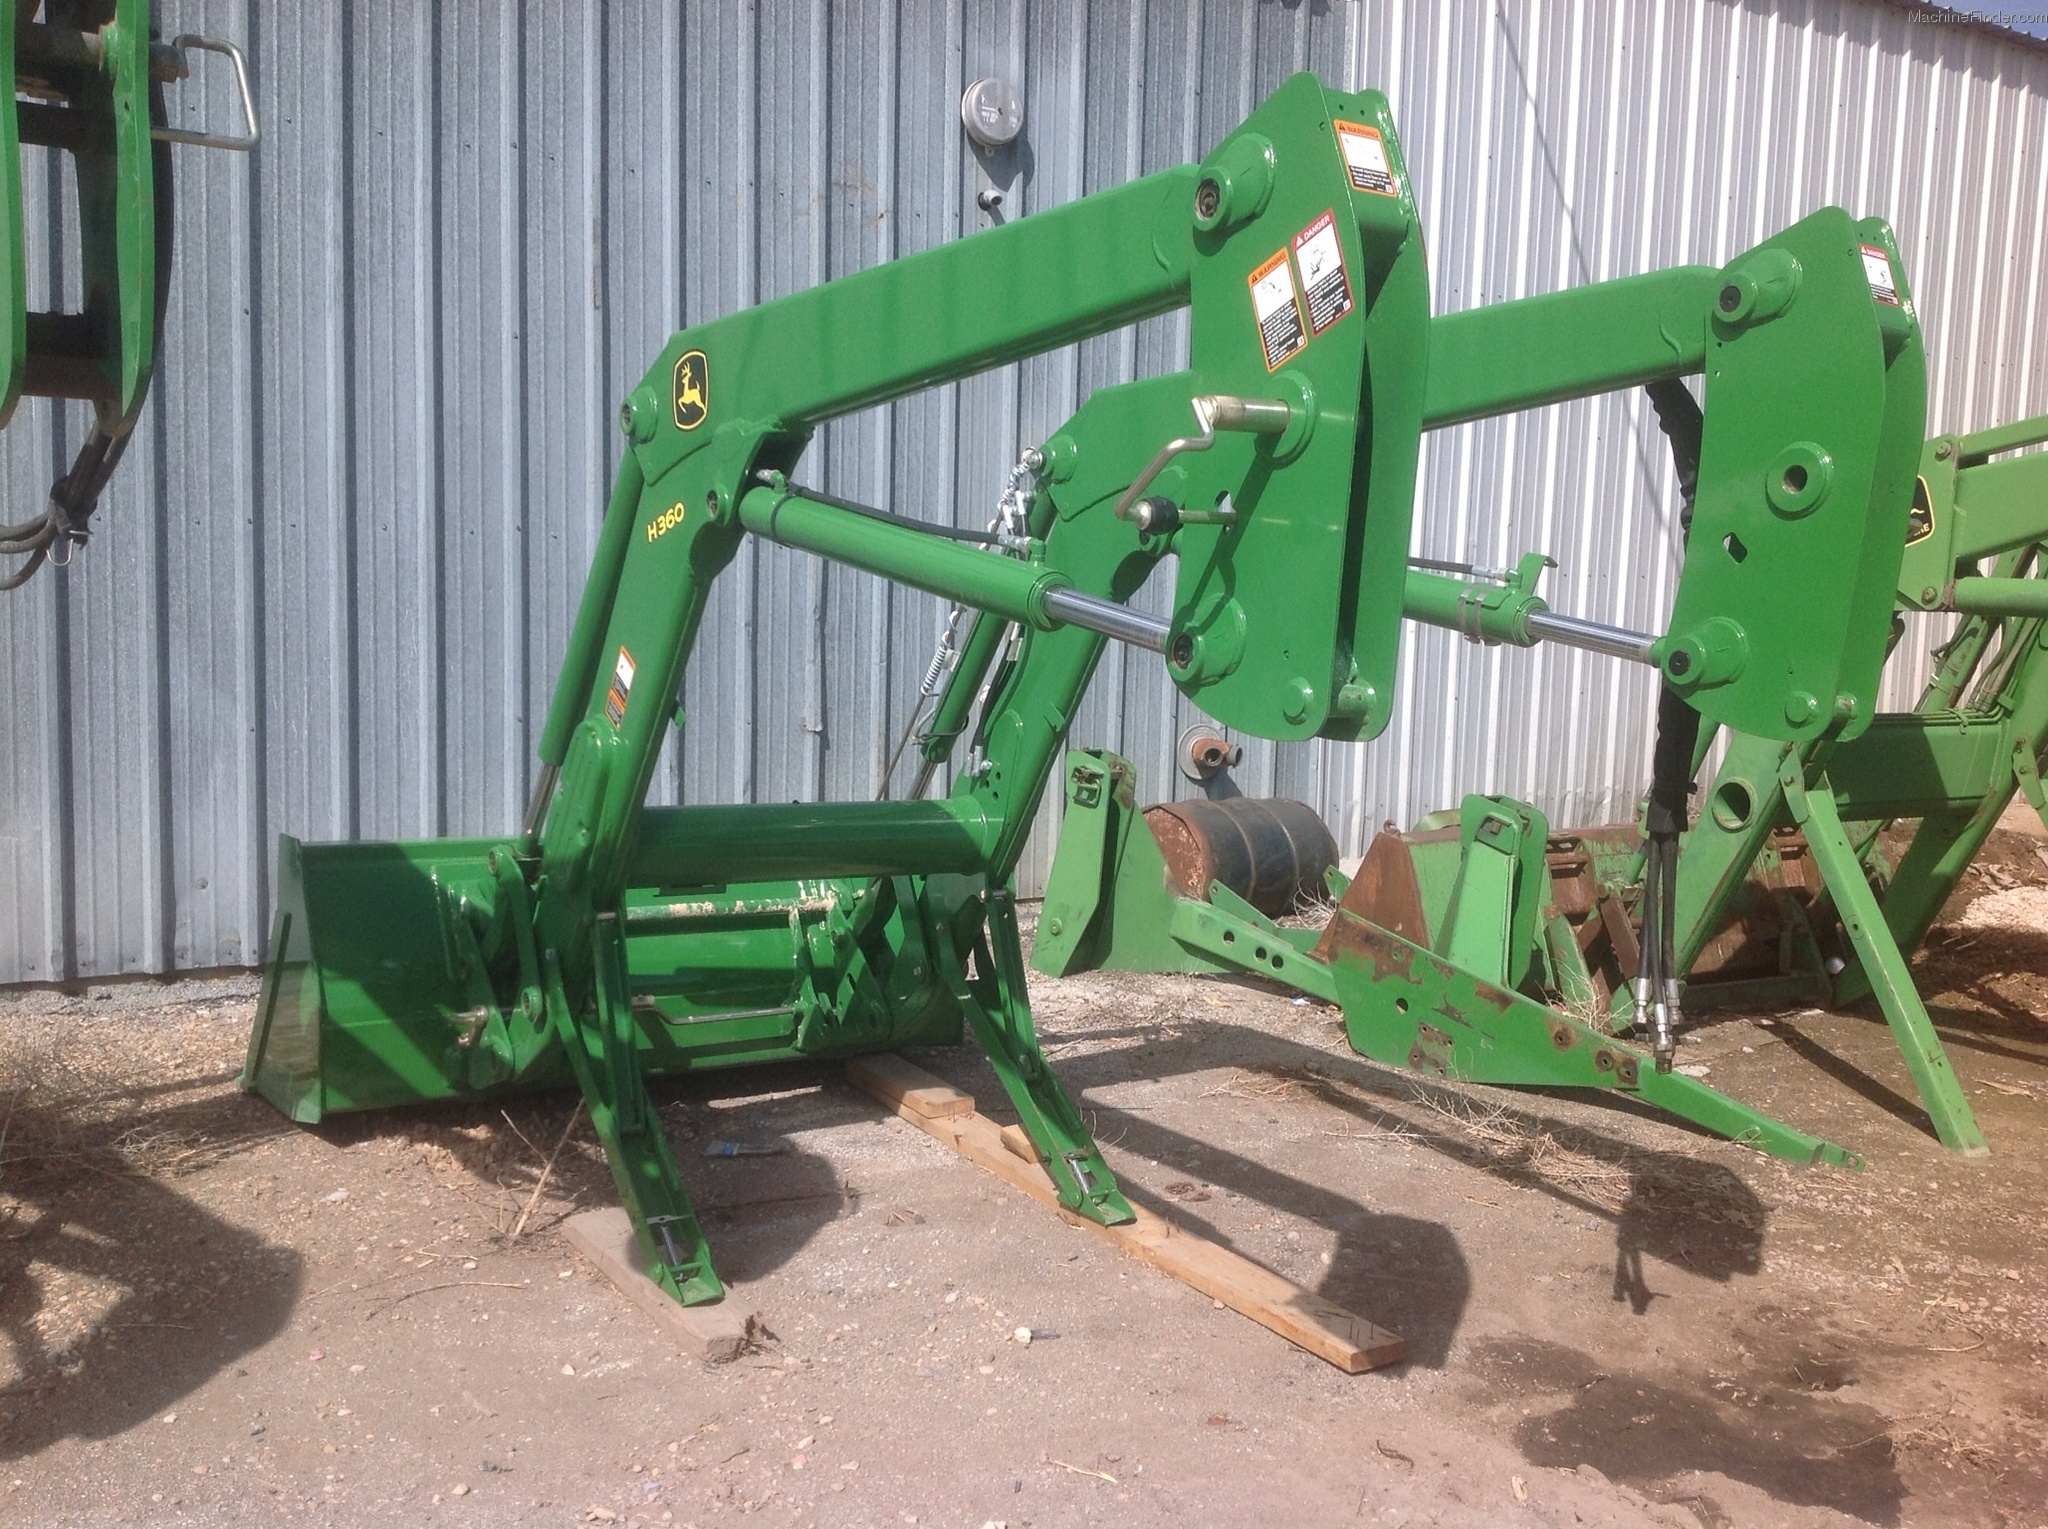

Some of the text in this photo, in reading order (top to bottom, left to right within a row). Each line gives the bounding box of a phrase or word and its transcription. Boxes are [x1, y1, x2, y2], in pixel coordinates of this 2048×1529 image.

[1347, 126, 1379, 138] WARNING
[1303, 214, 1331, 241] DANGER
[1258, 252, 1286, 277] WARNING
[647, 502, 685, 543] H360
